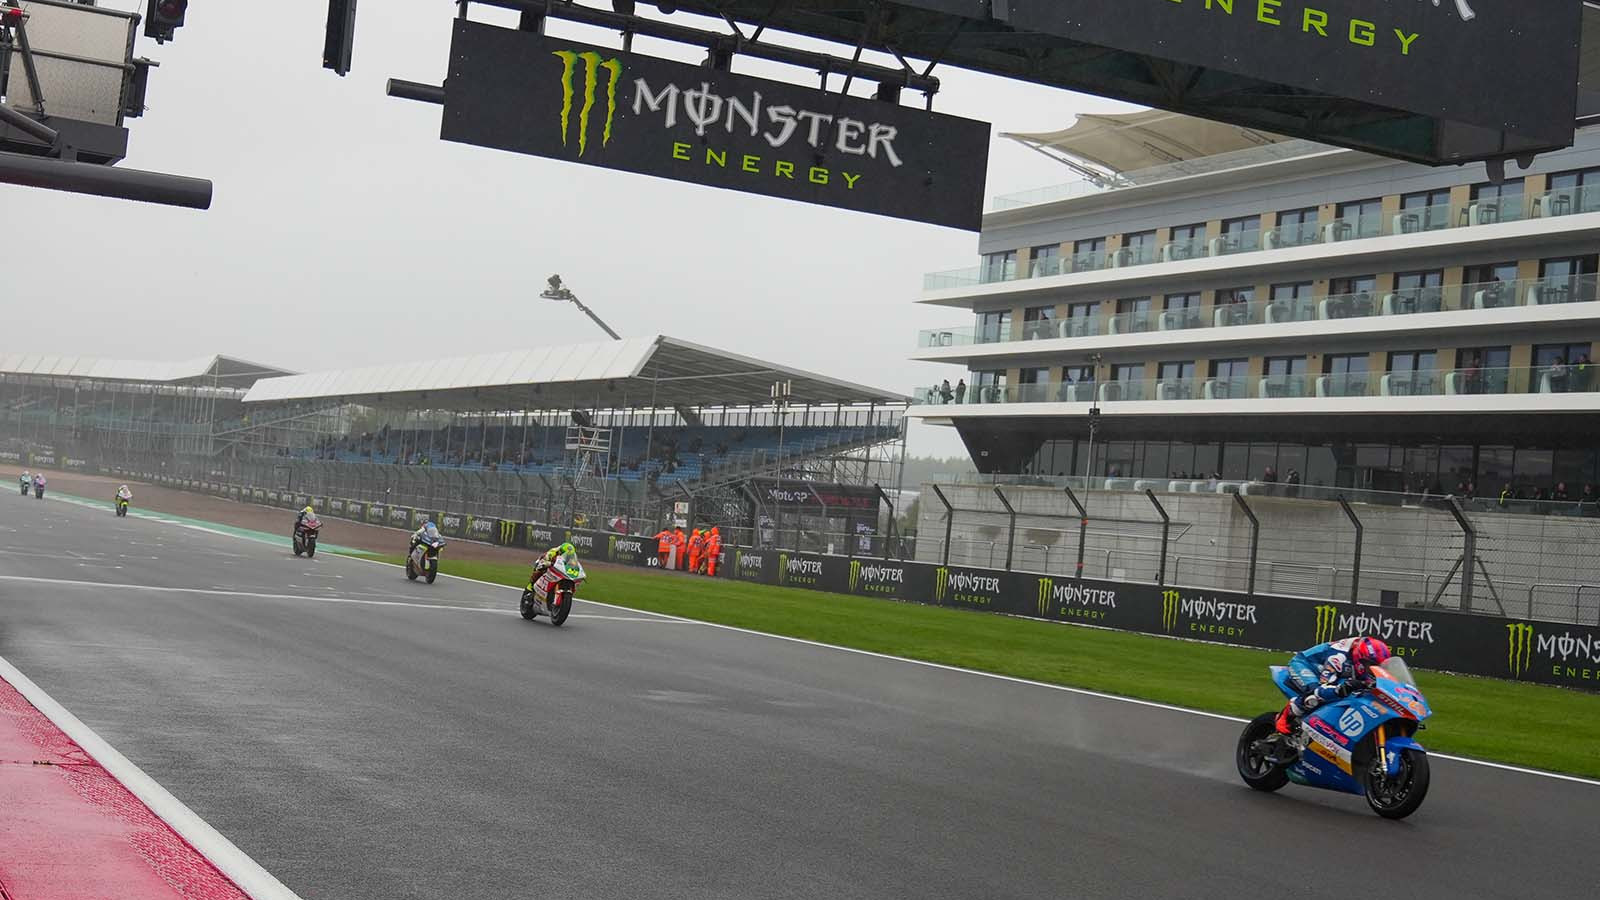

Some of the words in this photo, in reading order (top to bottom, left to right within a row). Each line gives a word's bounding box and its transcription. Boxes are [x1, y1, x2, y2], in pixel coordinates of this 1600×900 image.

[1165, 0, 1419, 55] NERGY
[632, 77, 902, 167] MONSTER
[672, 142, 863, 190] ENERGY
[615, 539, 642, 553] MONSTER
[740, 553, 762, 569] MONSTER
[786, 557, 822, 575] MONSTER
[860, 565, 903, 590] MONSTER
[865, 584, 896, 593] ENERGY
[948, 571, 1000, 594] MONSTER
[954, 594, 992, 605] ENERGY
[1052, 583, 1116, 608] MONSTER
[1060, 608, 1105, 620] ENERGY
[1181, 596, 1257, 624] MONSTER
[1190, 623, 1245, 636] ENERGY
[1339, 611, 1434, 644] MONSTER
[1380, 693, 1405, 716] STIHL
[1340, 709, 1362, 733] hp
